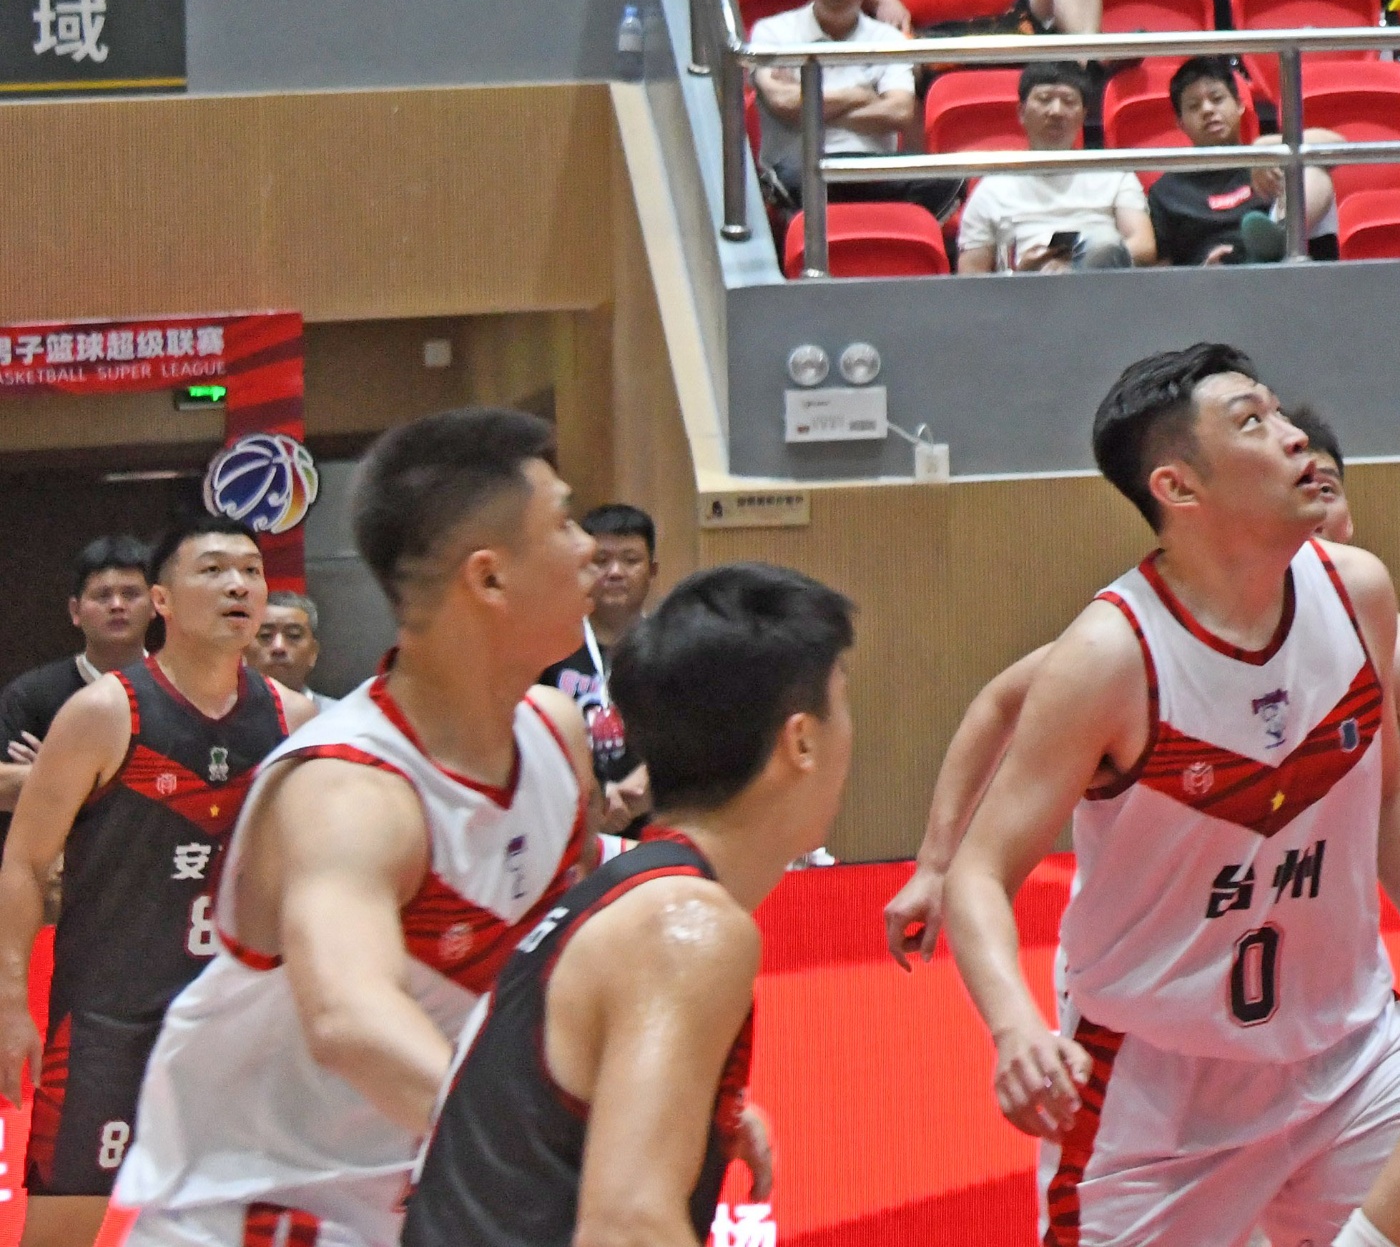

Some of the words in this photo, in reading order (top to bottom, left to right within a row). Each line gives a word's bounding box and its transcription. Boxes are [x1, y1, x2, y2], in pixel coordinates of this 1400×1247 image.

[97, 366, 152, 382] SUPER
[161, 360, 227, 378] LEAGUE
[1205, 838, 1328, 920] 台州
[1226, 920, 1285, 1028] 0
[97, 1118, 131, 1169] 8
